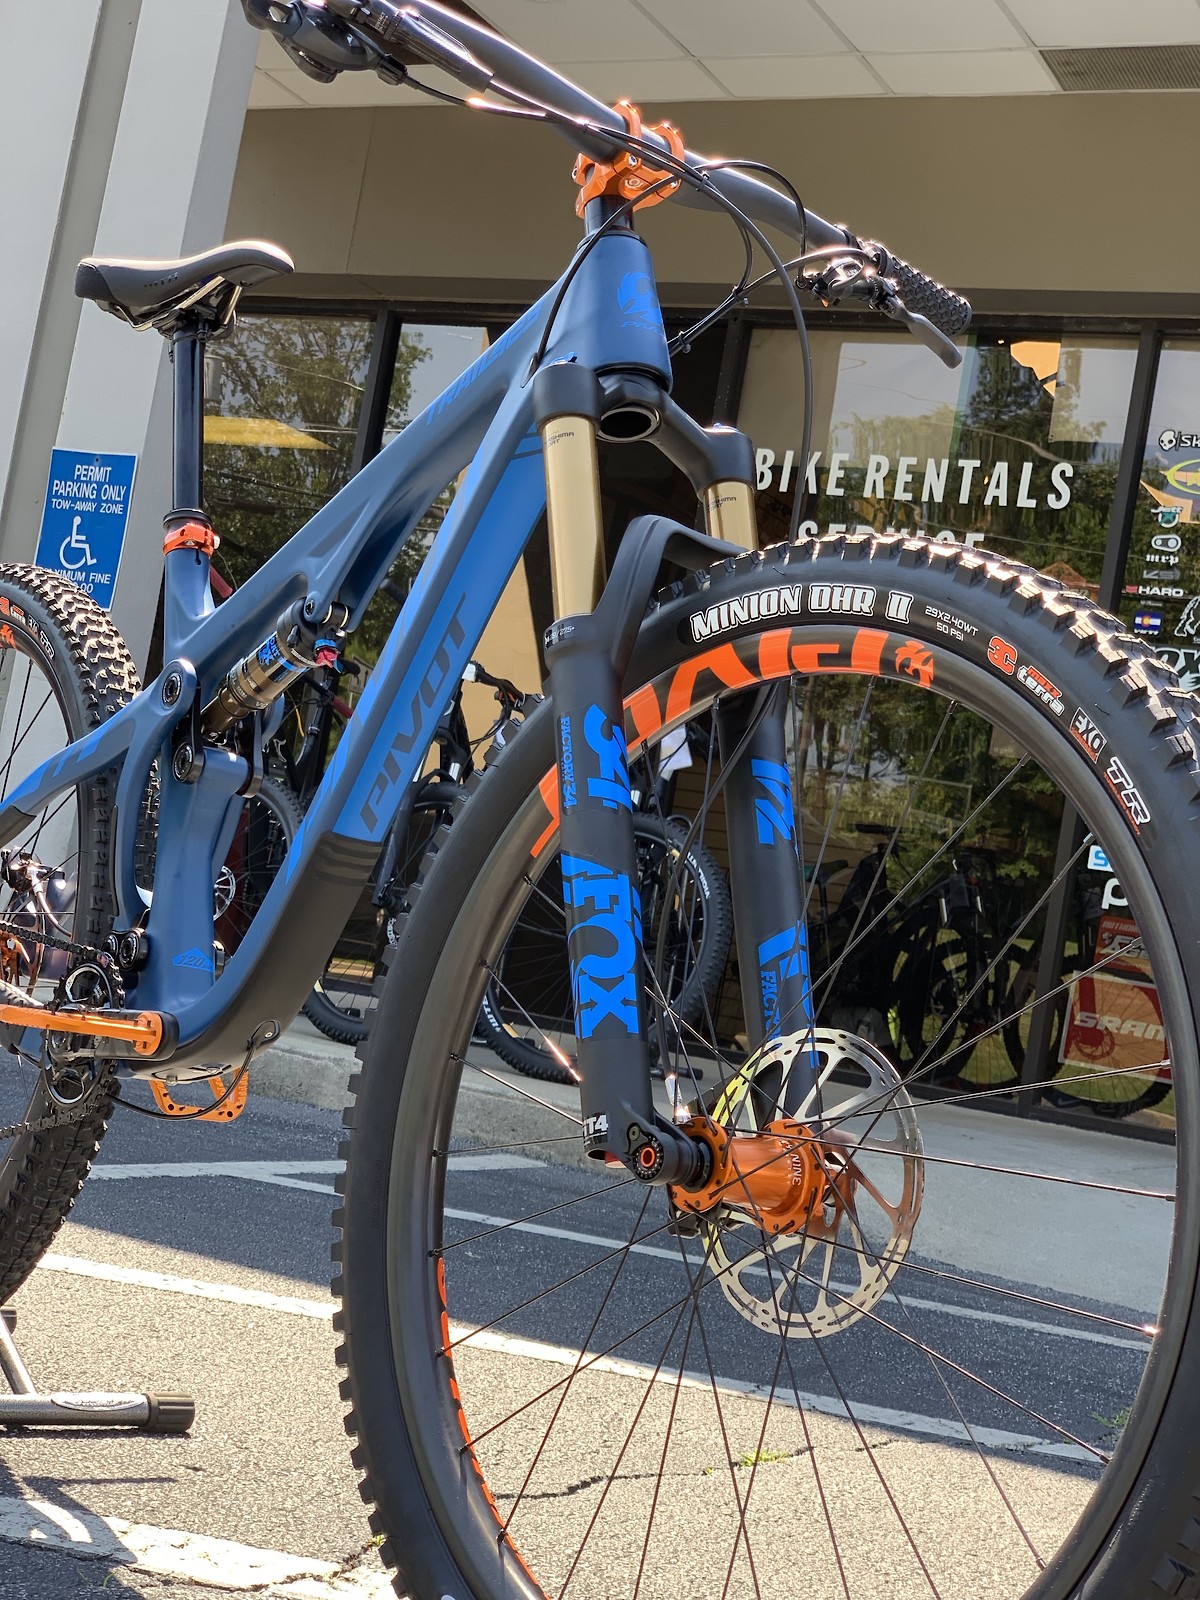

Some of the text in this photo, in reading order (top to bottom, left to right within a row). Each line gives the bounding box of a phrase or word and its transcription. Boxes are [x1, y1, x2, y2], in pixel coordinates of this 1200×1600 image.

[52, 480, 127, 501] PARKING ONLY
[74, 464, 112, 483] PERMIT
[757, 448, 1074, 509] BIKE RENTALS
[51, 498, 124, 515] TOW-AWAY ZONE
[48, 568, 112, 585] XIMUM FINE
[1138, 585, 1184, 597] HARO
[690, 584, 802, 643] MINION
[808, 583, 877, 617] DHR
[925, 605, 979, 637] 29X2.40WT
[936, 621, 964, 642] 50 PSI
[987, 636, 1018, 675] 3C
[359, 592, 466, 834] PIVOT
[1071, 710, 1107, 756] EXO
[560, 716, 578, 809] FACTORY 34
[1106, 756, 1151, 825] TR
[566, 862, 640, 1040] FOX
[791, 1153, 803, 1187] NINE
